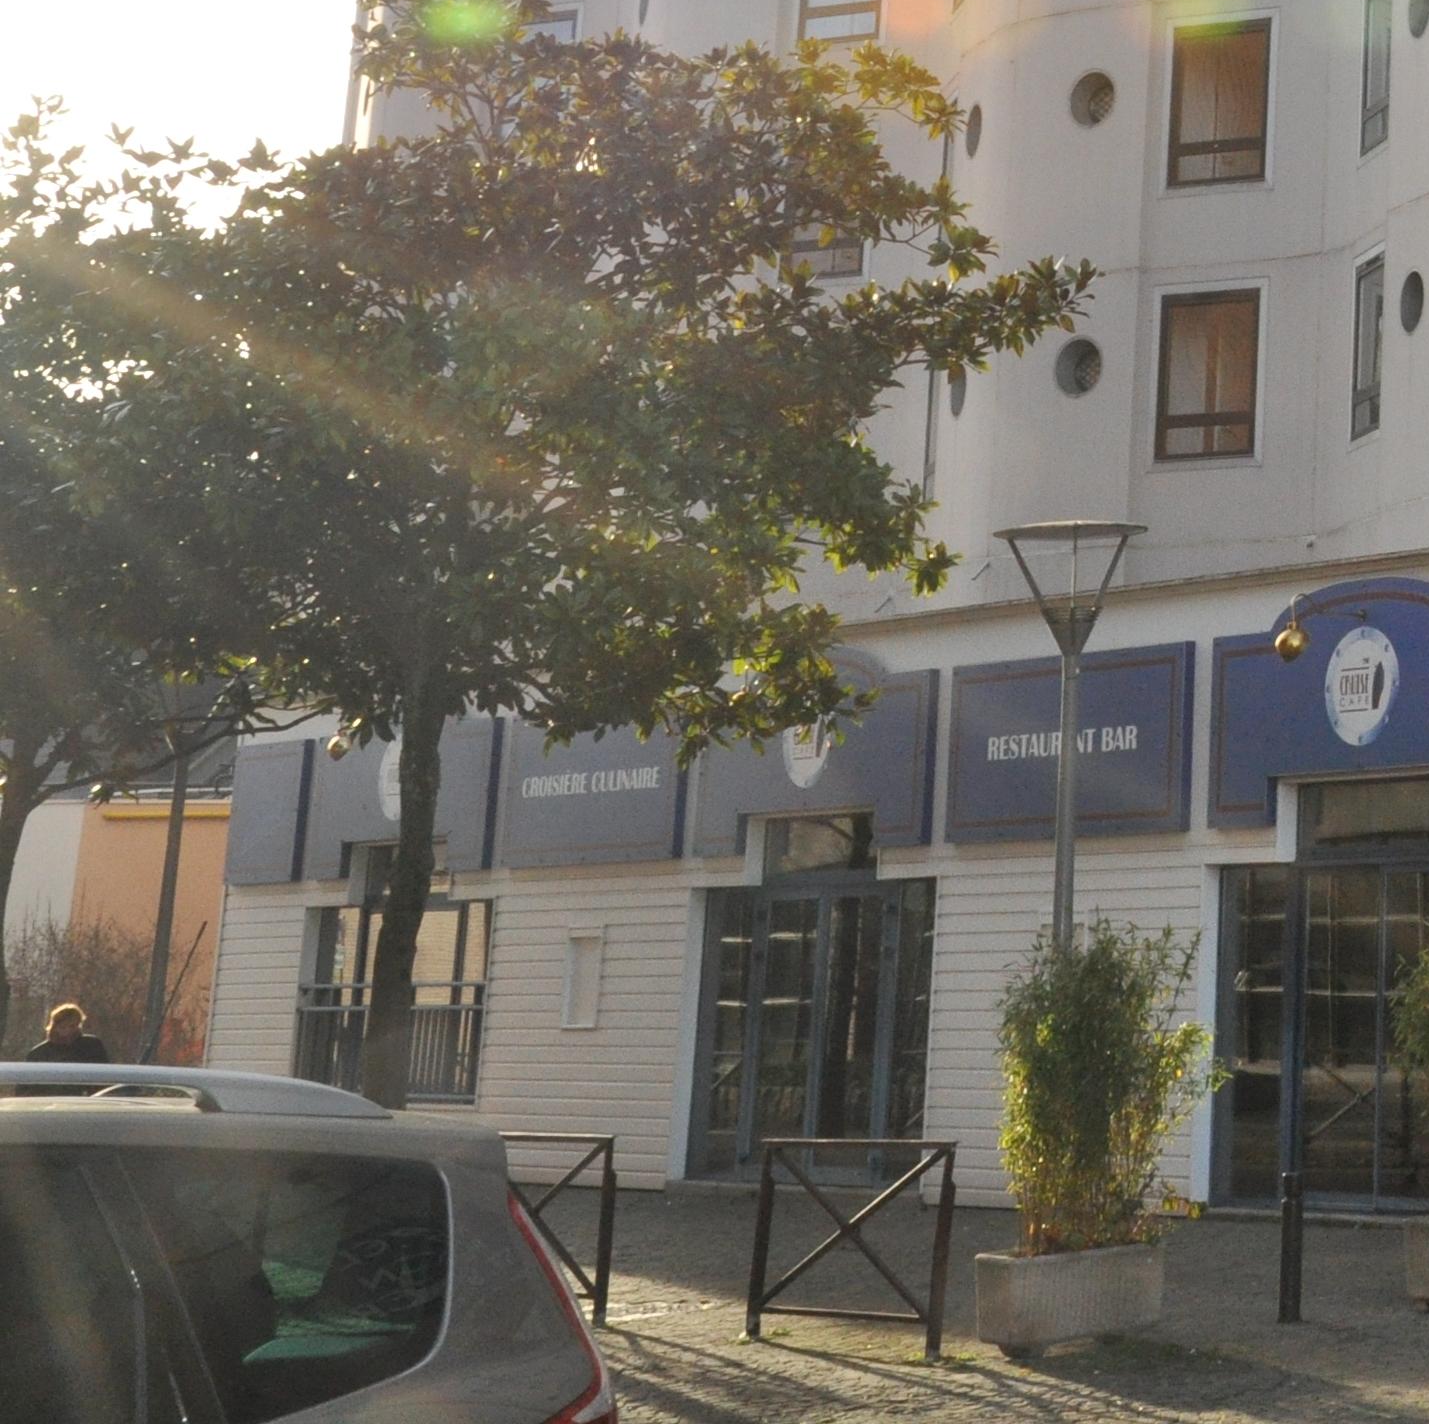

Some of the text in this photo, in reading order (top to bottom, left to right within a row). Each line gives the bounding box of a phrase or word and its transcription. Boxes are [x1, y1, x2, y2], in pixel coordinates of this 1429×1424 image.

[986, 724, 1139, 762] RESTAURNT BAR
[522, 766, 661, 799] CROISIÈRE CULINAIRE
